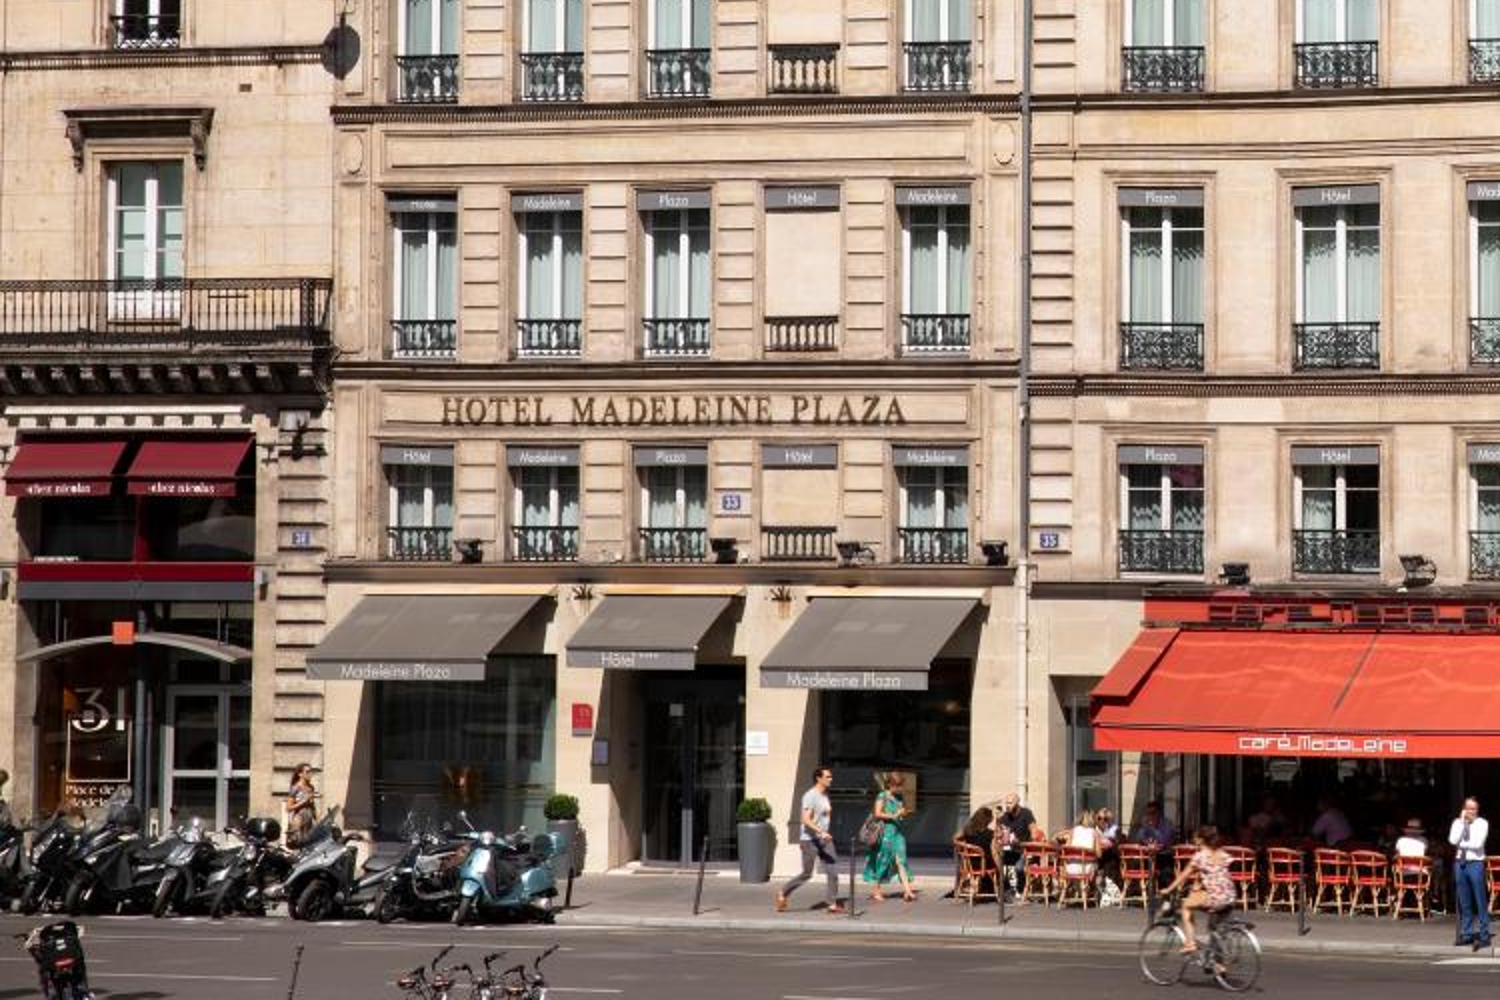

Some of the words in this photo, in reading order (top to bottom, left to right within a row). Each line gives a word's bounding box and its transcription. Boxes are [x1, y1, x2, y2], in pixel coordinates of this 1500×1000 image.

[523, 195, 571, 209] Madeleine
[659, 194, 688, 207] Plaza
[788, 192, 816, 206] Hôtel
[907, 190, 958, 203] Madeleine
[1145, 191, 1177, 204] Plaza
[1321, 189, 1351, 202] Hôtel
[442, 397, 552, 426] HOTEL
[572, 396, 773, 426] MADELEINE
[791, 395, 907, 425] PLAZA
[403, 450, 431, 463] Hôtel
[520, 451, 568, 463] Madeleine
[656, 450, 688, 463] Plaza
[785, 449, 814, 463] Hôtel
[906, 450, 957, 463] Madeleine
[1144, 448, 1177, 462] Plaza
[1321, 448, 1351, 464] Hôtel
[1042, 535, 1057, 547] 35
[601, 651, 635, 667] Hôtel
[341, 664, 409, 679] Madeleine
[413, 663, 450, 680] Plaza
[787, 671, 859, 687] Madeleine
[863, 672, 900, 688] Plaza
[72, 687, 126, 732] 31
